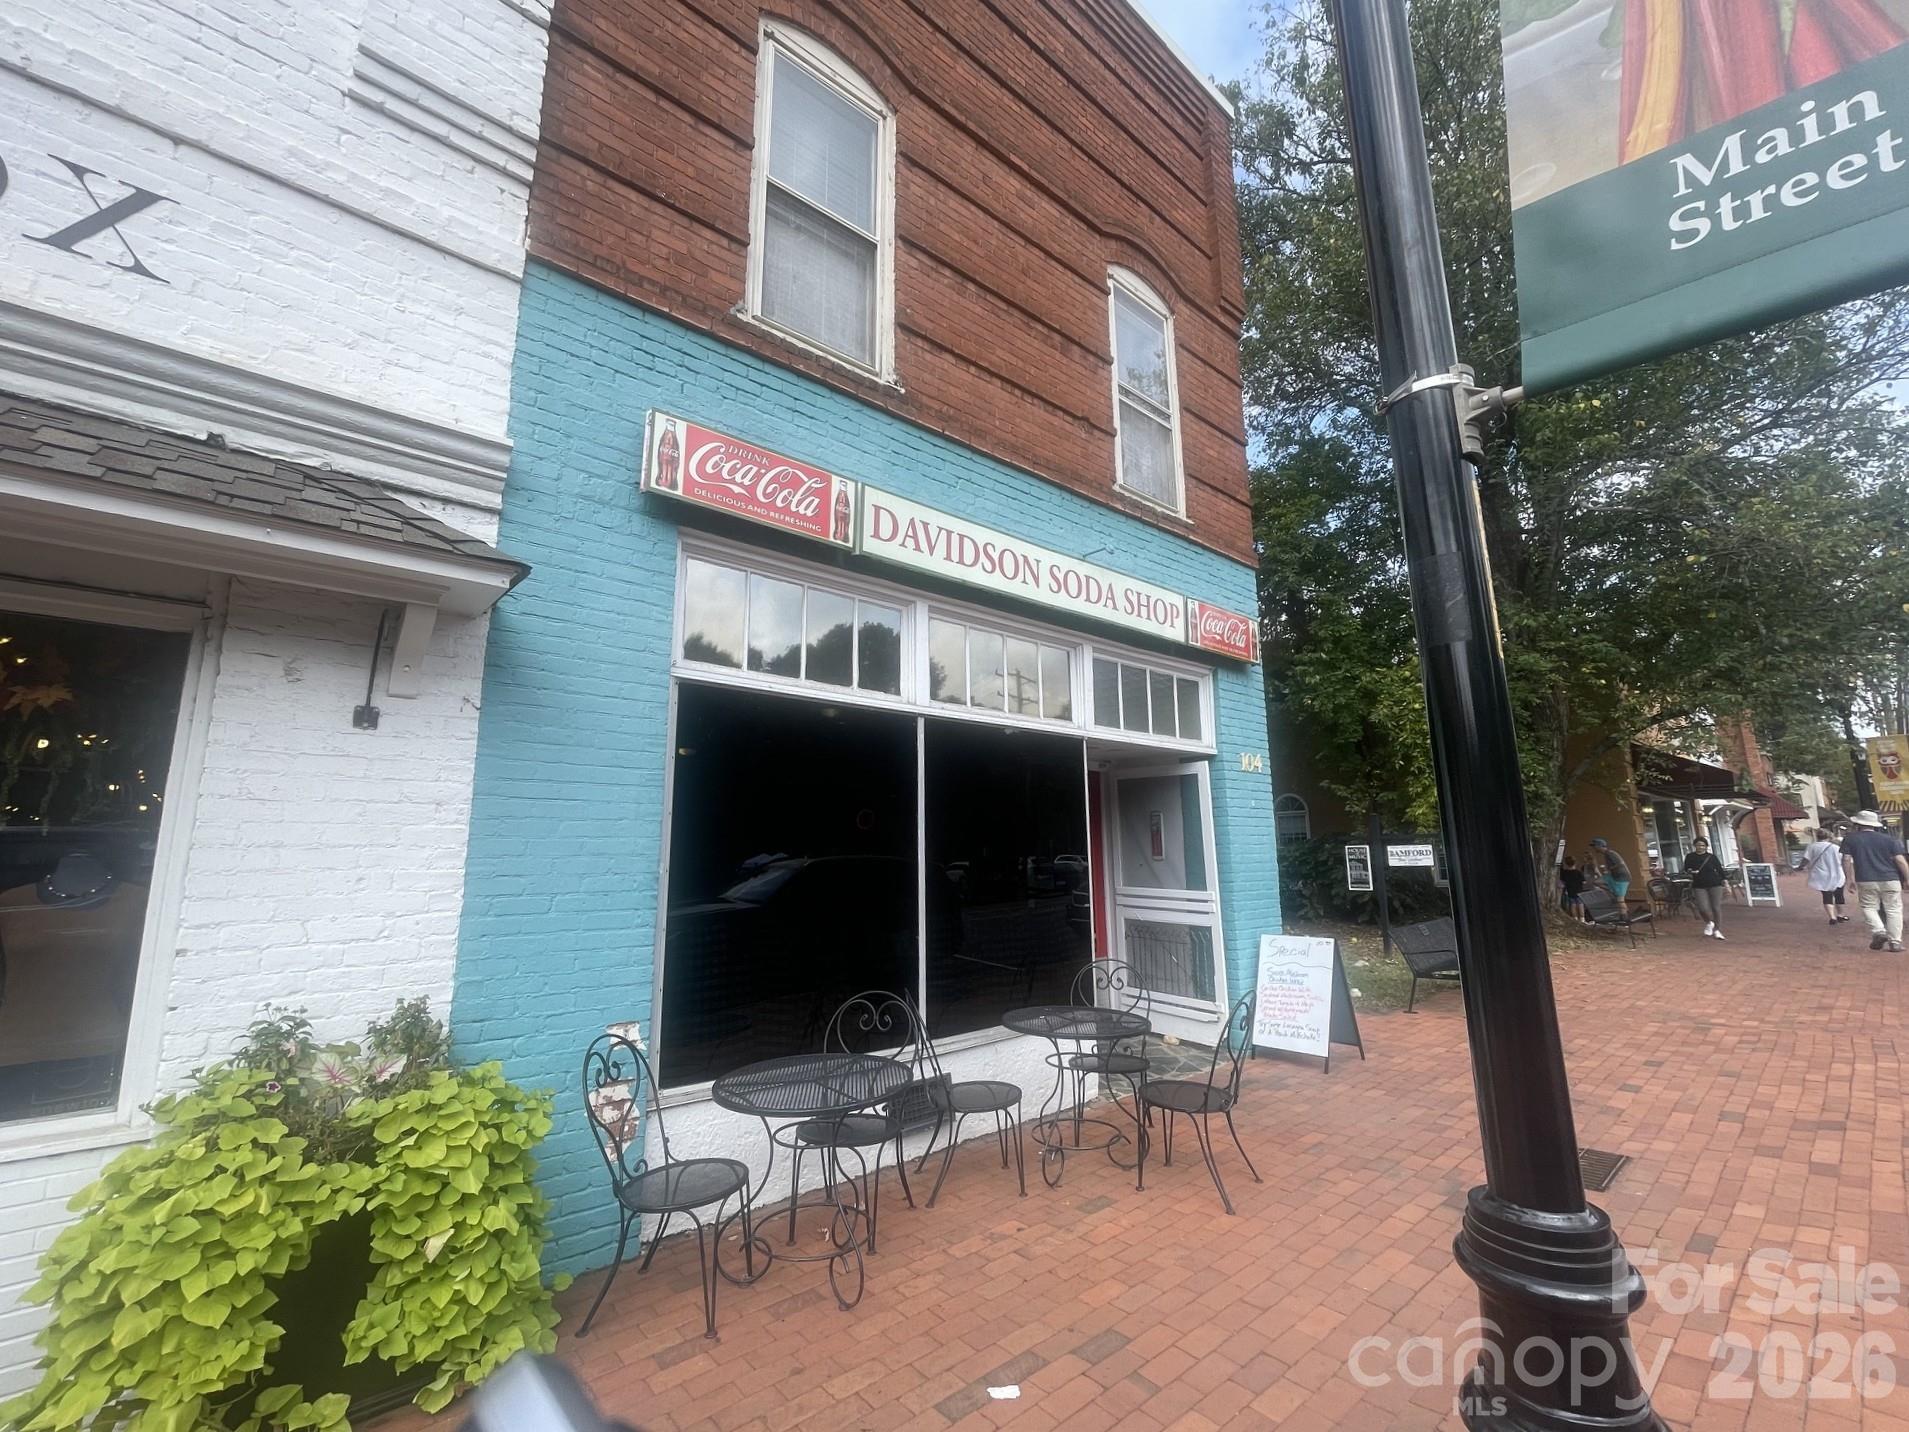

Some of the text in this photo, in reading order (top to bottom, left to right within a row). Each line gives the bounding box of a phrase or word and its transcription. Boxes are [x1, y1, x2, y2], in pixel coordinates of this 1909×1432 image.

[1668, 89, 1887, 198] Main
[0, 154, 181, 284] X
[1668, 128, 1906, 250] Street
[689, 442, 827, 517] Coca-Cola
[728, 445, 770, 466] DRINK
[694, 487, 822, 532] DELICIOUS AND REFRESHING
[870, 503, 1181, 629] DAVIDSON SODA SHOP
[1201, 611, 1248, 648] Coca-Cola
[1239, 752, 1262, 773] 104
[1389, 849, 1432, 858] BAMFORD
